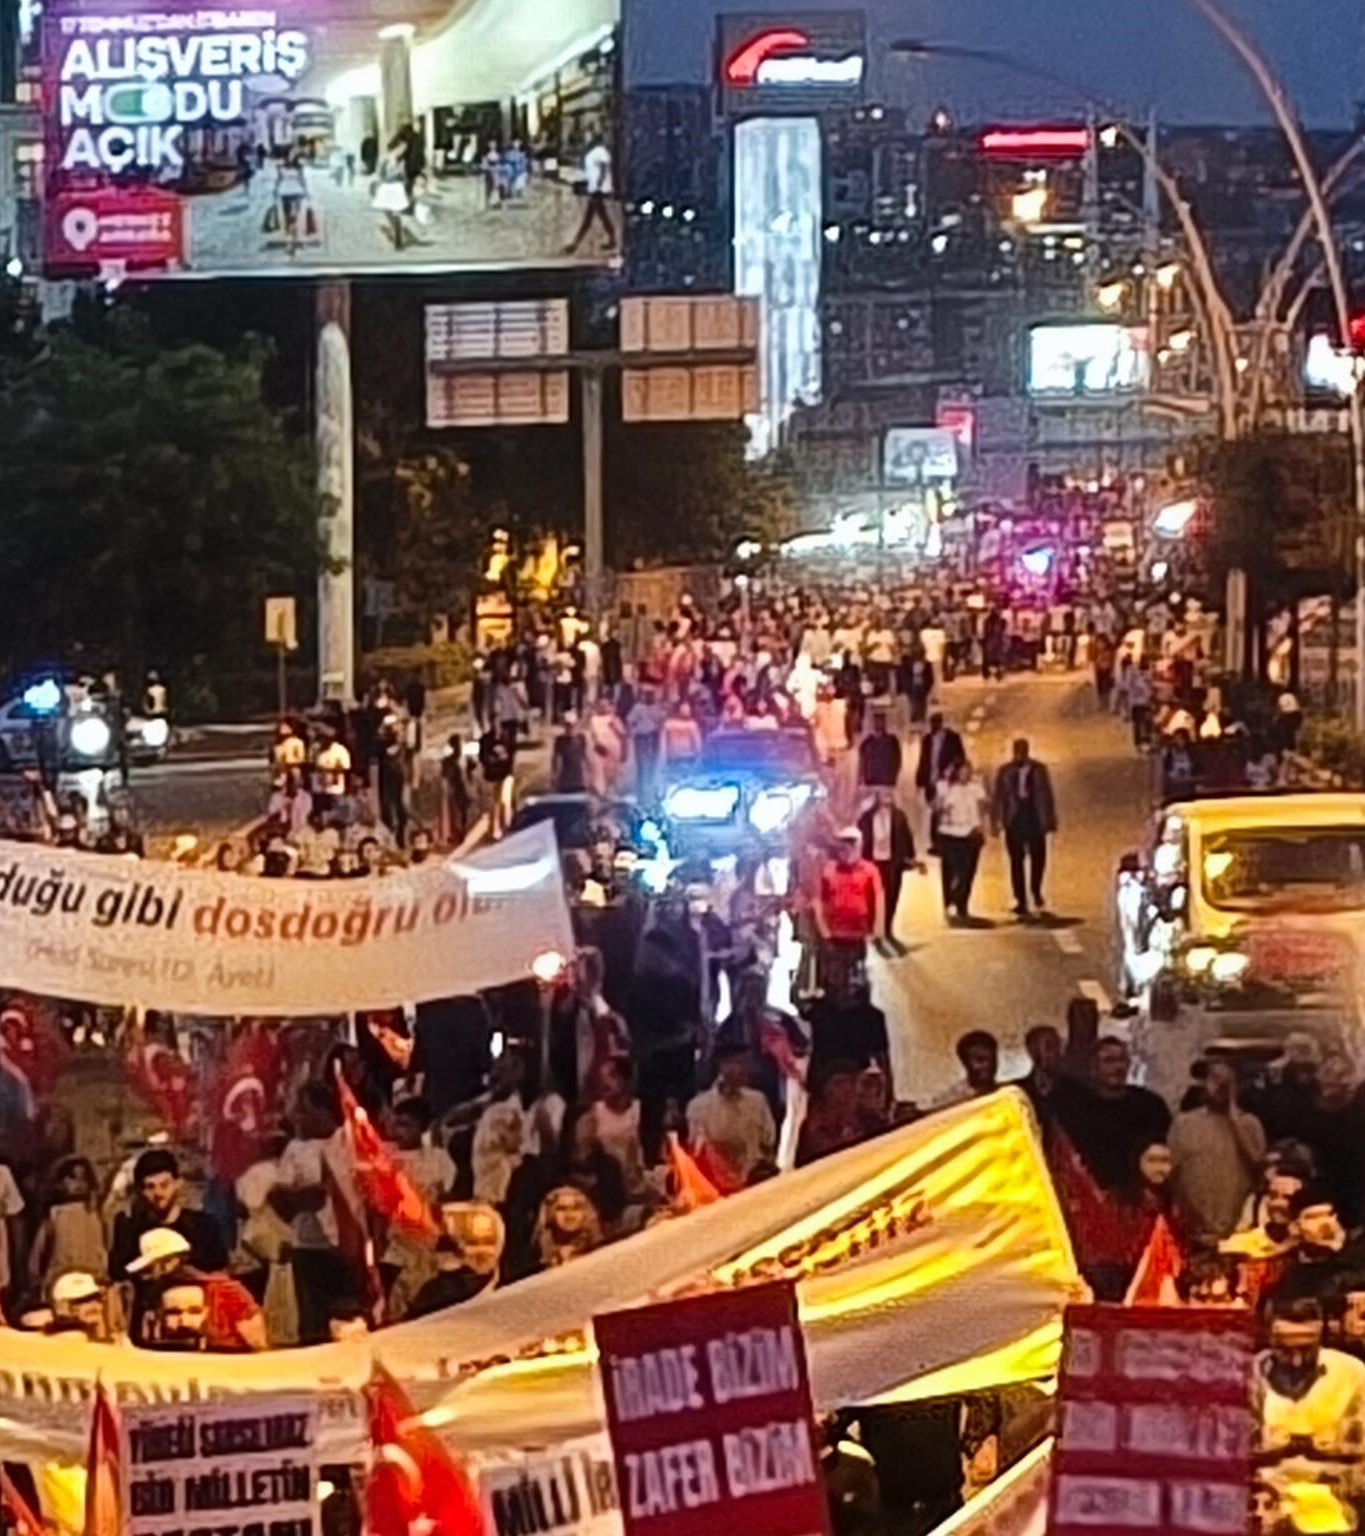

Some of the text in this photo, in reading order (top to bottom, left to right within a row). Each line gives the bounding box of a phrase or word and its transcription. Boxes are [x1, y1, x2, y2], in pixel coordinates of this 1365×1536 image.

[61, 30, 308, 83] ALIŞVERİŞ
[63, 125, 184, 174] AÇIK
[91, 883, 184, 930] gibi
[193, 895, 418, 947] dosdoğru
[624, 1438, 719, 1519] ZAFER
